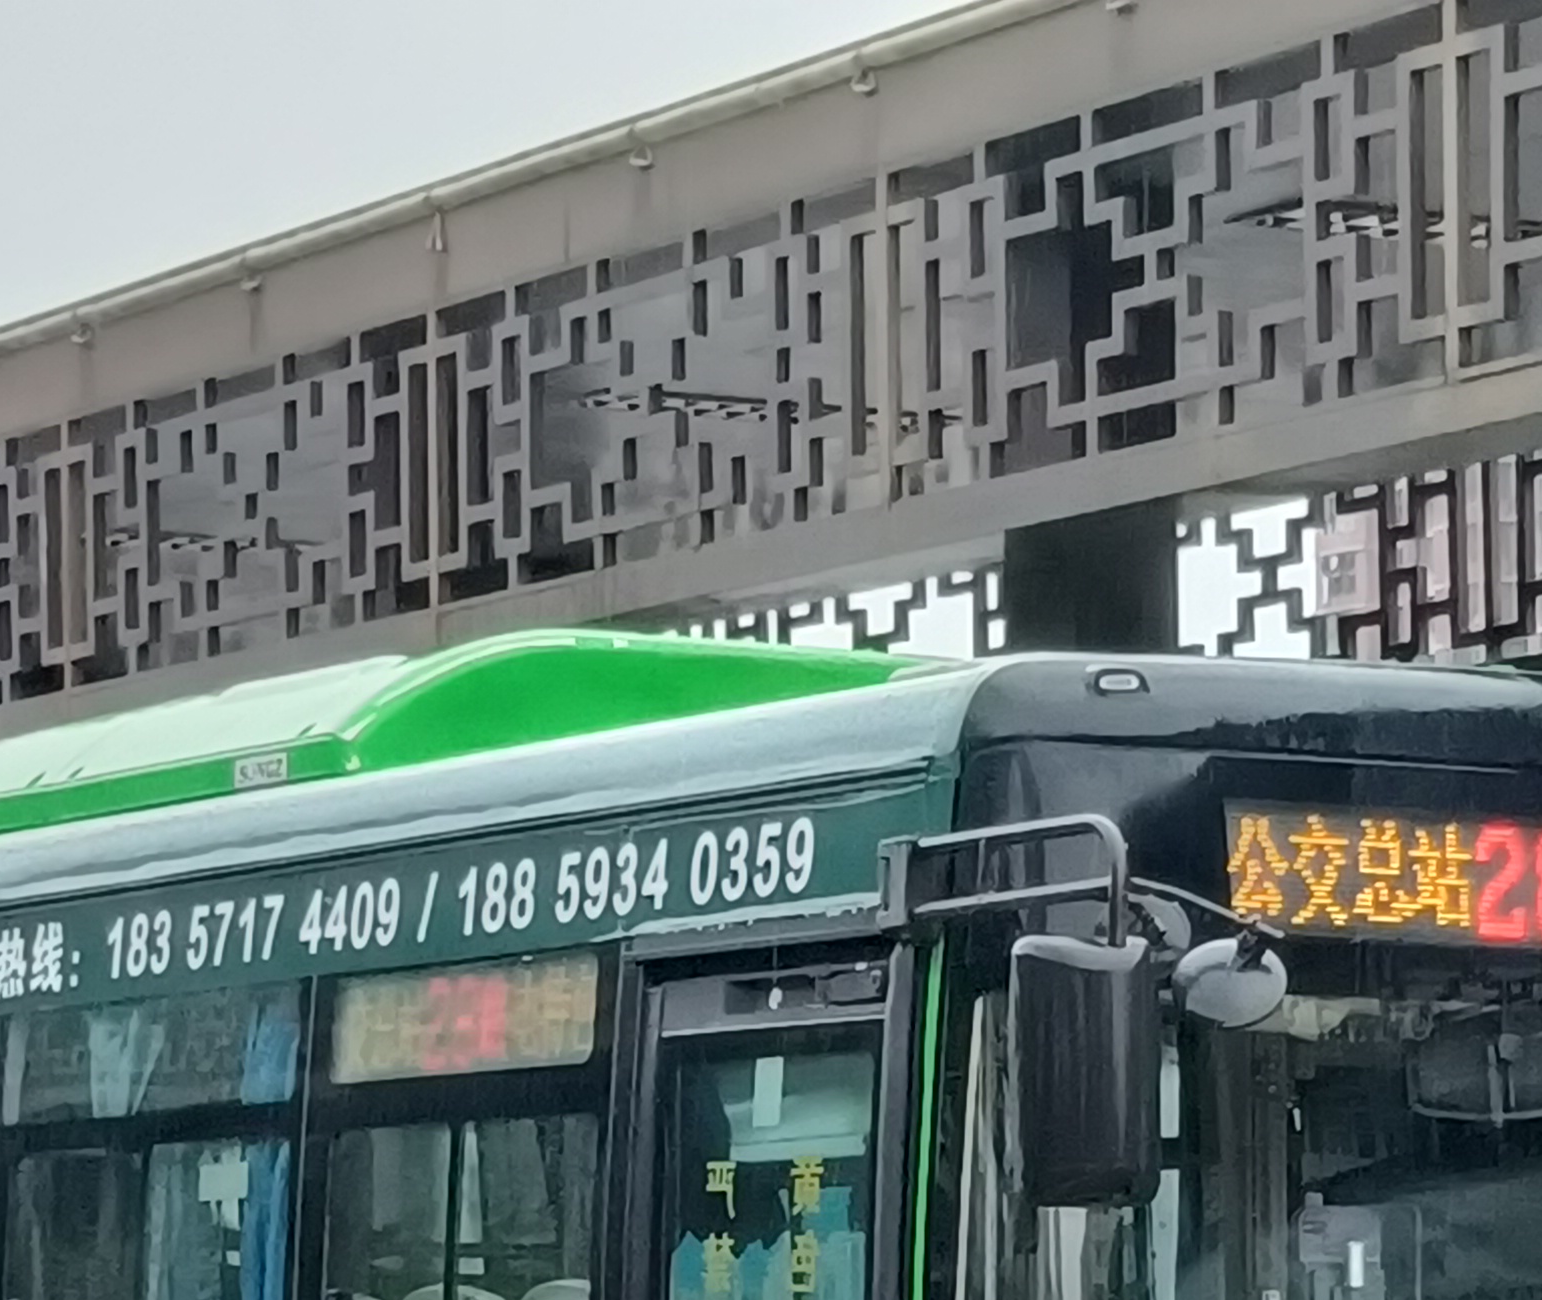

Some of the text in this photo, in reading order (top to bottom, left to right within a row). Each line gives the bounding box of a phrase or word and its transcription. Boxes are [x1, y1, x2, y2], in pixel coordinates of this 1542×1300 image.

[106, 909, 173, 980] 183
[185, 893, 286, 971] 5717
[298, 876, 401, 955] 4409
[458, 857, 537, 936] 188
[554, 837, 669, 923] 5934
[689, 816, 816, 906] 0359
